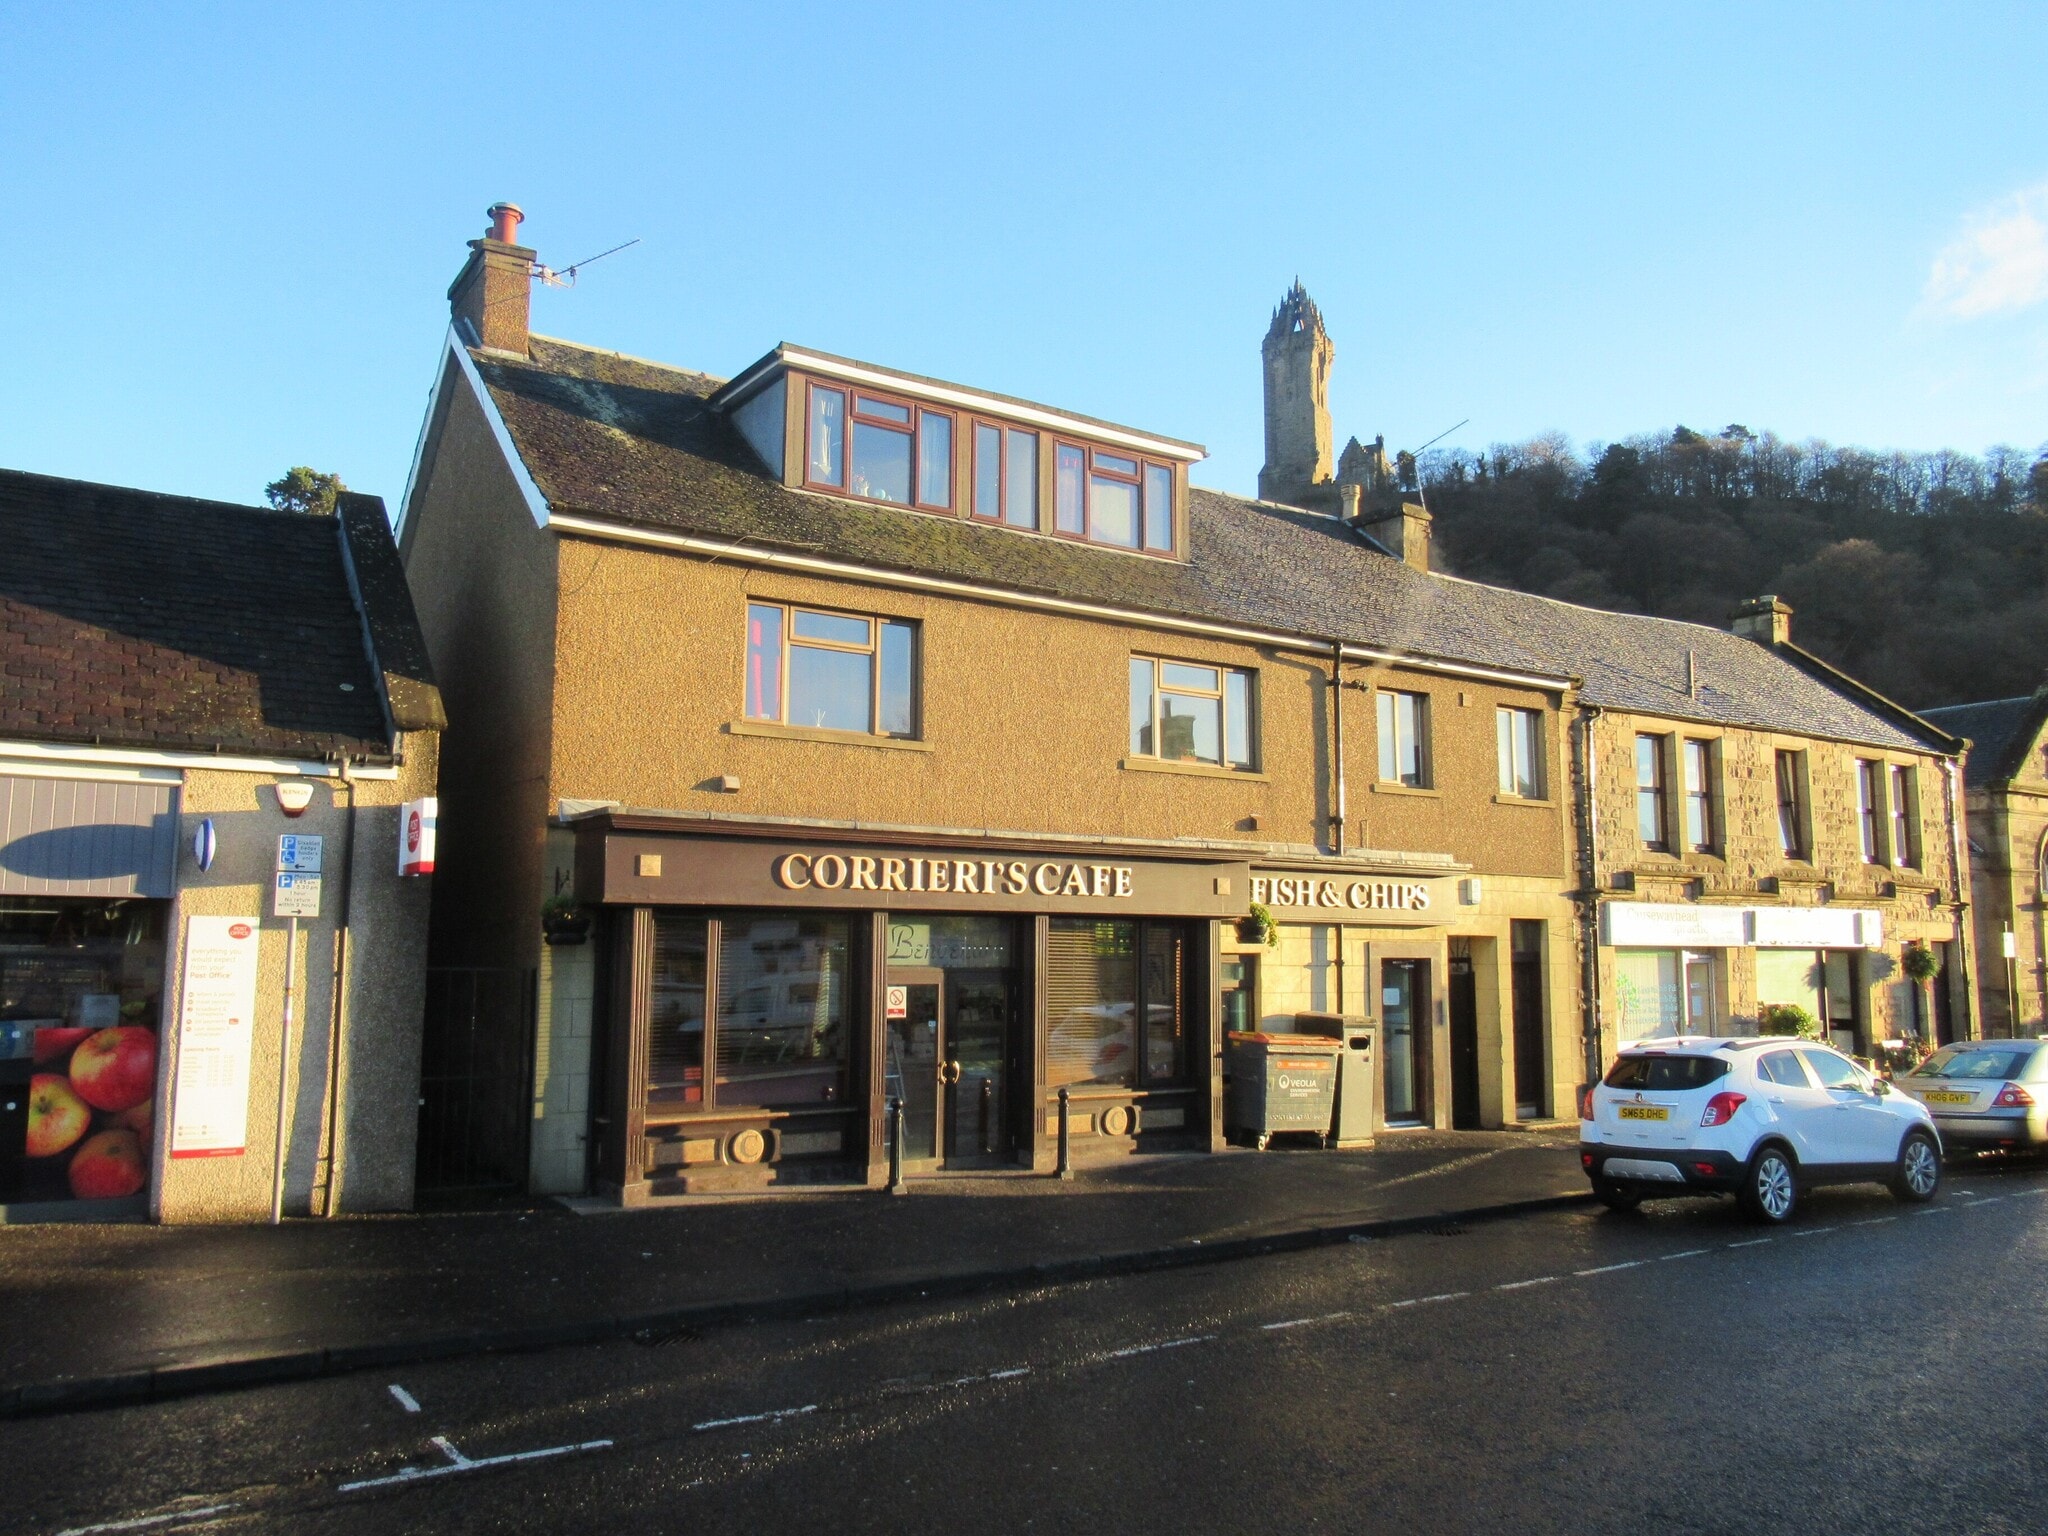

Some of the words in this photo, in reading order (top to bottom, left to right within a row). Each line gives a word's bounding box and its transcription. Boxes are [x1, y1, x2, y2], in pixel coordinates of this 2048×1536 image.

[780, 853, 1027, 894] CORRIERI'S
[1034, 863, 1134, 898] CAFE
[1251, 877, 1316, 906] FISH
[1321, 880, 1344, 907] &
[1349, 882, 1430, 910] CHIPS
[1622, 1108, 1645, 1118] SM65
[1646, 1109, 1665, 1118] DHE
